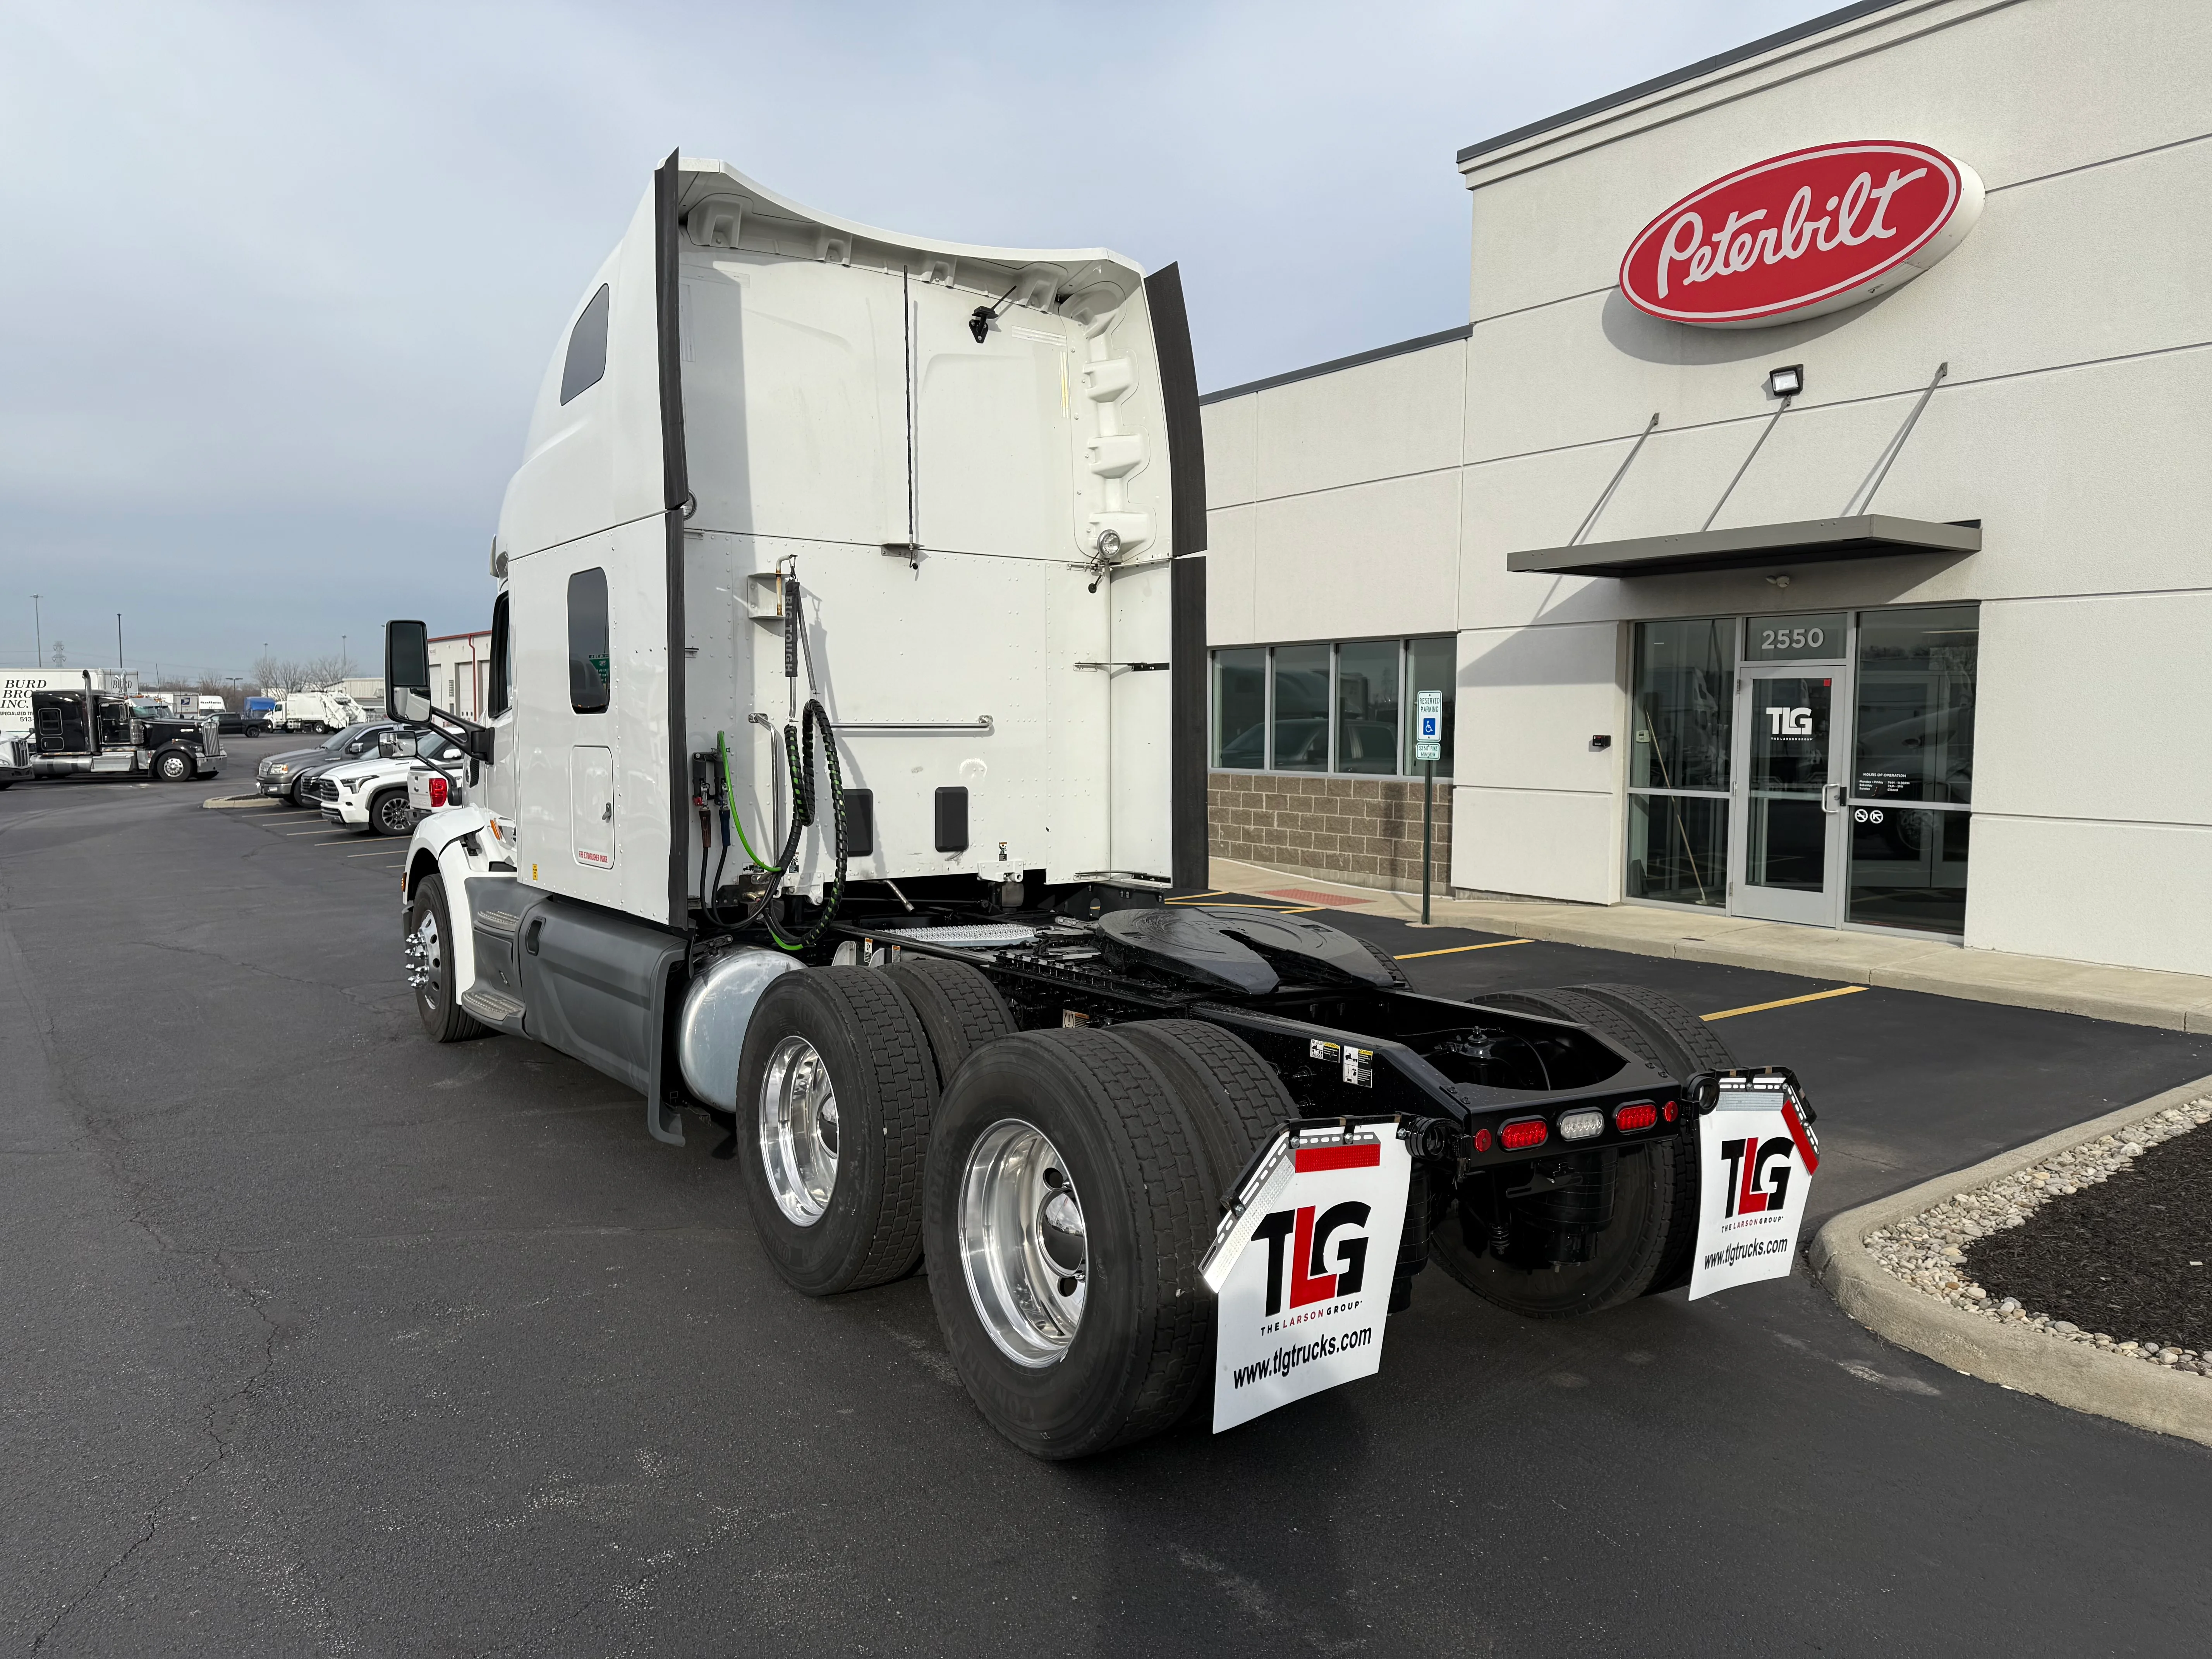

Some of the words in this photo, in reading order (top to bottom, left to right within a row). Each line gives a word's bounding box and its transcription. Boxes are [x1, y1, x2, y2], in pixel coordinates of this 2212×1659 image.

[1657, 167, 1927, 299] Peterbilt
[1761, 628, 1824, 649] 2550
[2, 690, 33, 698] BRO
[5, 680, 47, 688] BURD
[113, 680, 132, 689] BD
[0, 699, 29, 708] INC.
[1766, 707, 1812, 735] TLG
[1721, 1137, 1795, 1219] TLG
[1722, 1224, 1732, 1233] THE
[1733, 1218, 1758, 1229] LARSON
[1759, 1216, 1781, 1224] GROUP
[1251, 1201, 1371, 1317] TLG
[1705, 1238, 1788, 1270] www.tlgtrucks.com
[1261, 1322, 1279, 1336] THE
[1283, 1309, 1323, 1328] LARSON
[1326, 1301, 1359, 1316] GROUP
[1234, 1327, 1372, 1389] www.tlgtrucks.com
